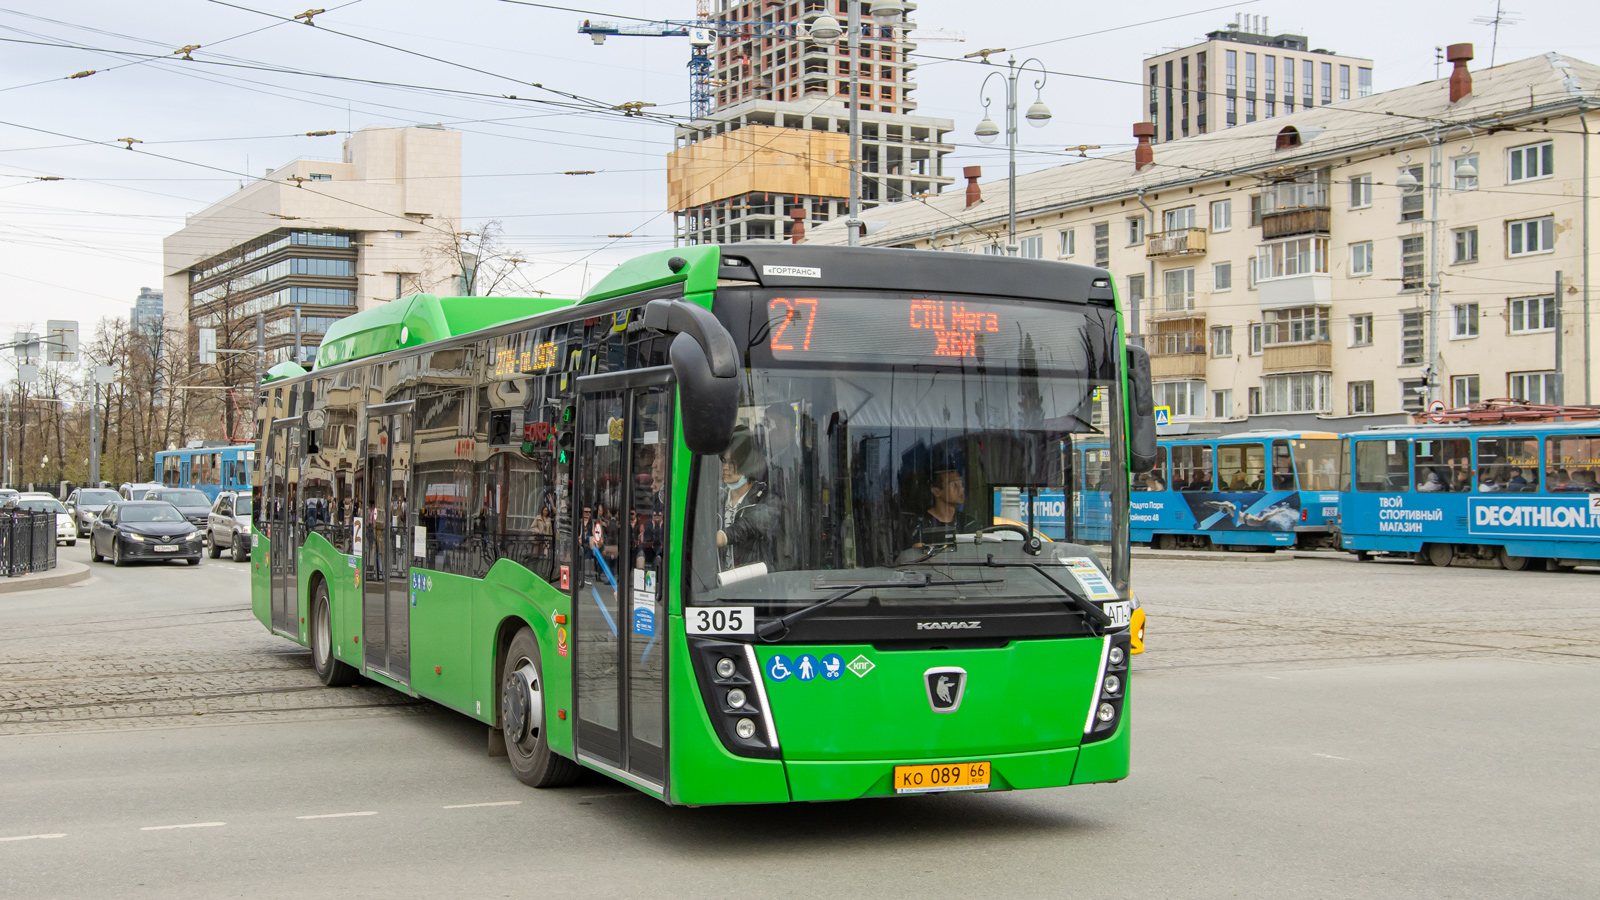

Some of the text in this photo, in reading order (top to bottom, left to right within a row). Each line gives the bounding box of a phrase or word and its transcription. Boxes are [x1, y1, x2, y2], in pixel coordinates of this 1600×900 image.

[768, 267, 816, 276] «ГОРТРАНС»
[770, 297, 818, 351] 27
[934, 331, 976, 357] ЖБИ
[1379, 495, 1403, 508] ТВОЙ
[1130, 513, 1151, 522] айнера
[1379, 508, 1443, 521] СПОРТИВНЫЙ
[1379, 521, 1423, 532] МАГАЗИН
[696, 609, 743, 632] 305
[916, 621, 982, 630] KAMAZ
[853, 662, 869, 670] КПГ
[930, 767, 961, 784] 089
[970, 764, 985, 777] 66
